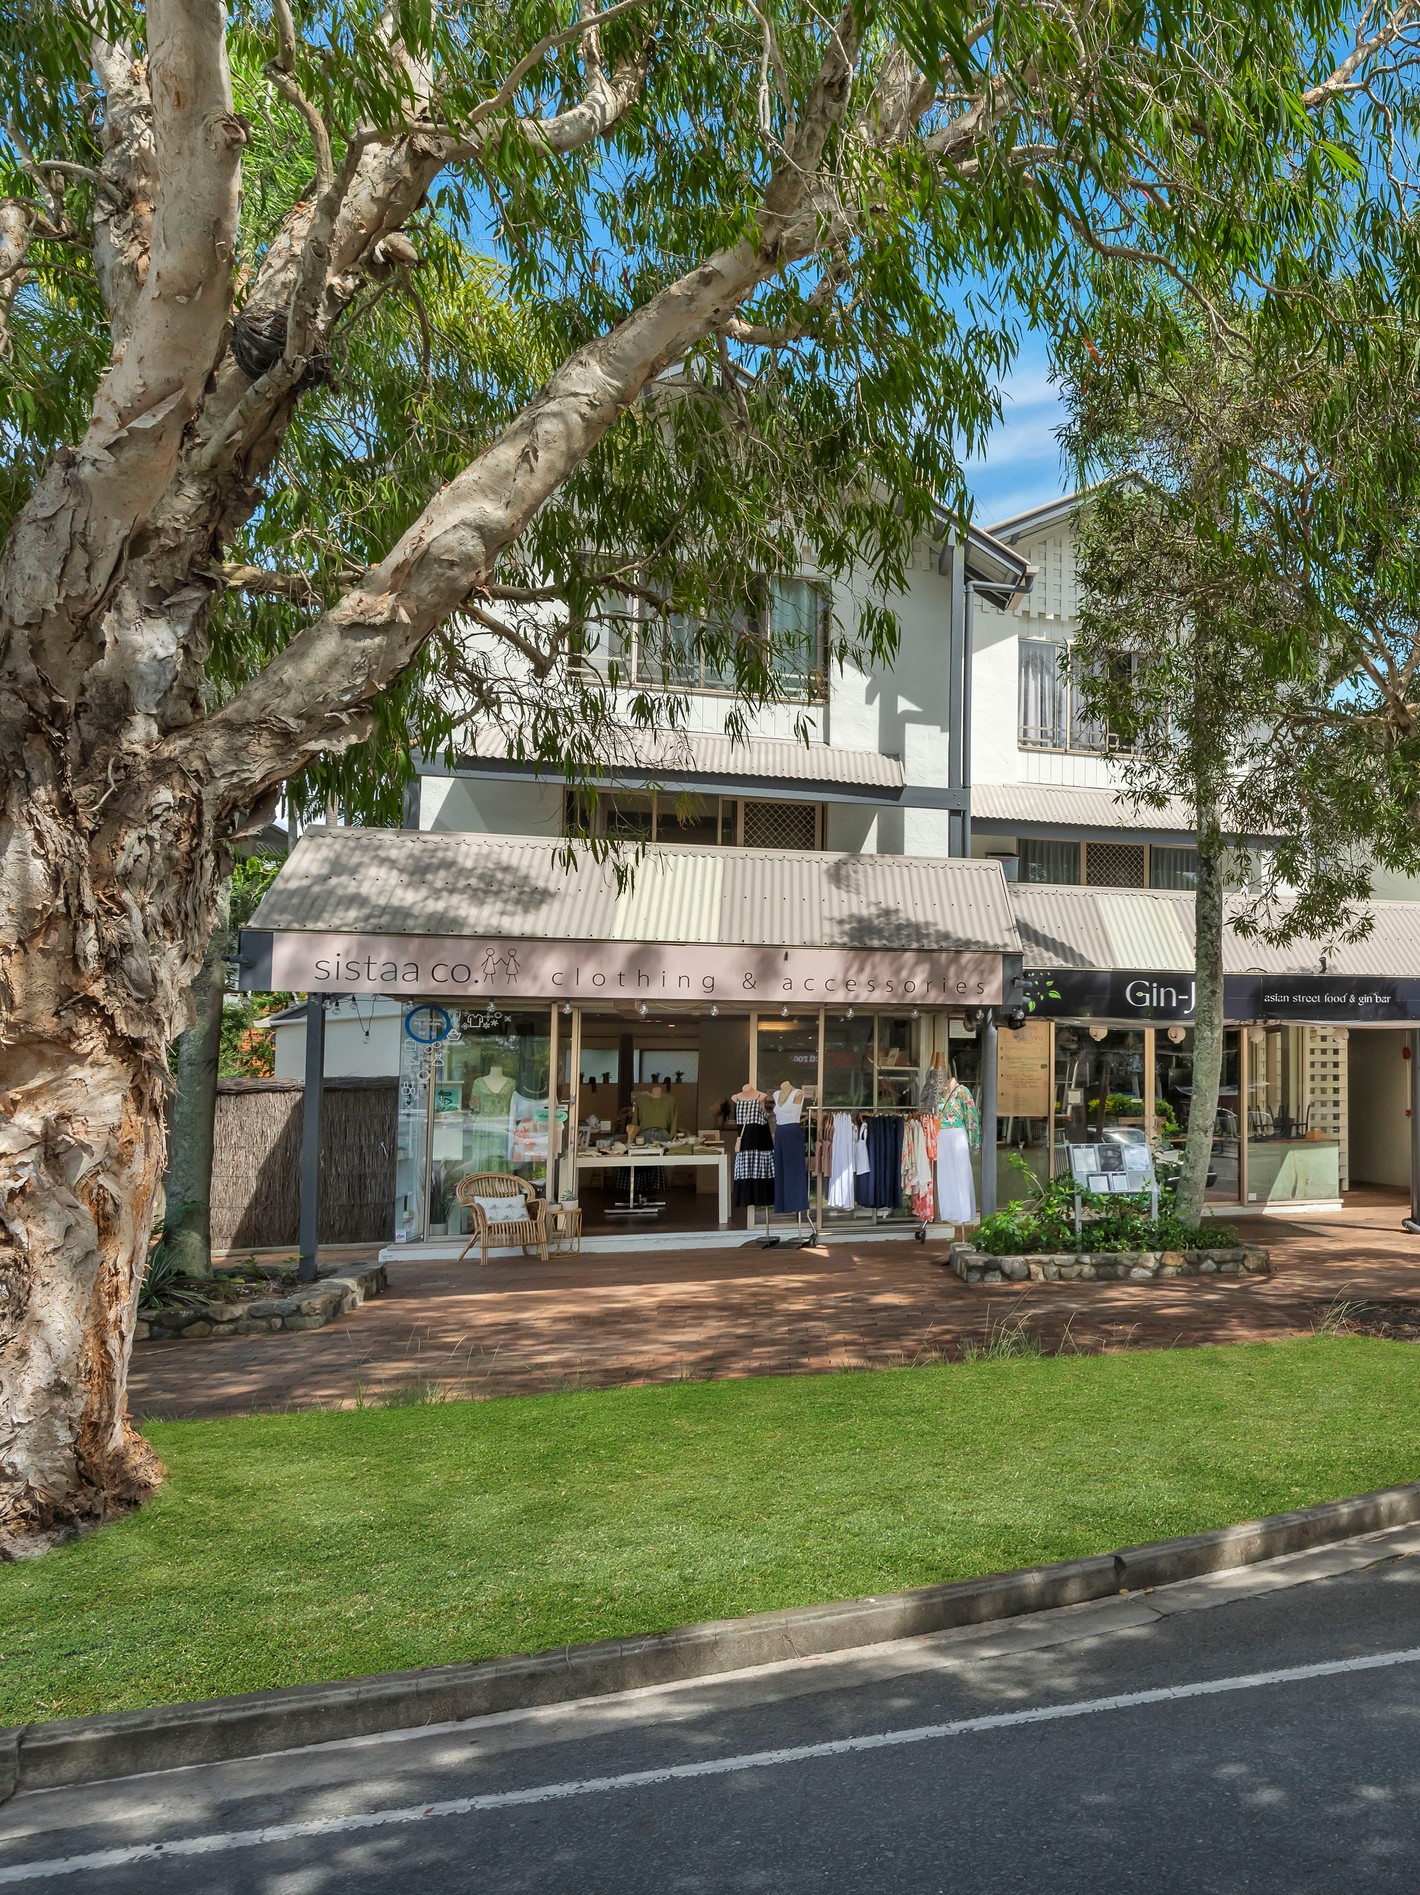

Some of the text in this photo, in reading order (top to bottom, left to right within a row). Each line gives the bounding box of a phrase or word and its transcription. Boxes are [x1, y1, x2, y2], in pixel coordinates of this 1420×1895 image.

[314, 952, 479, 984] sistaa co.
[551, 967, 985, 995] clothing & accessories
[1125, 979, 1196, 1014] Gin-J
[1263, 992, 1391, 1006] asian street food & gin bar
